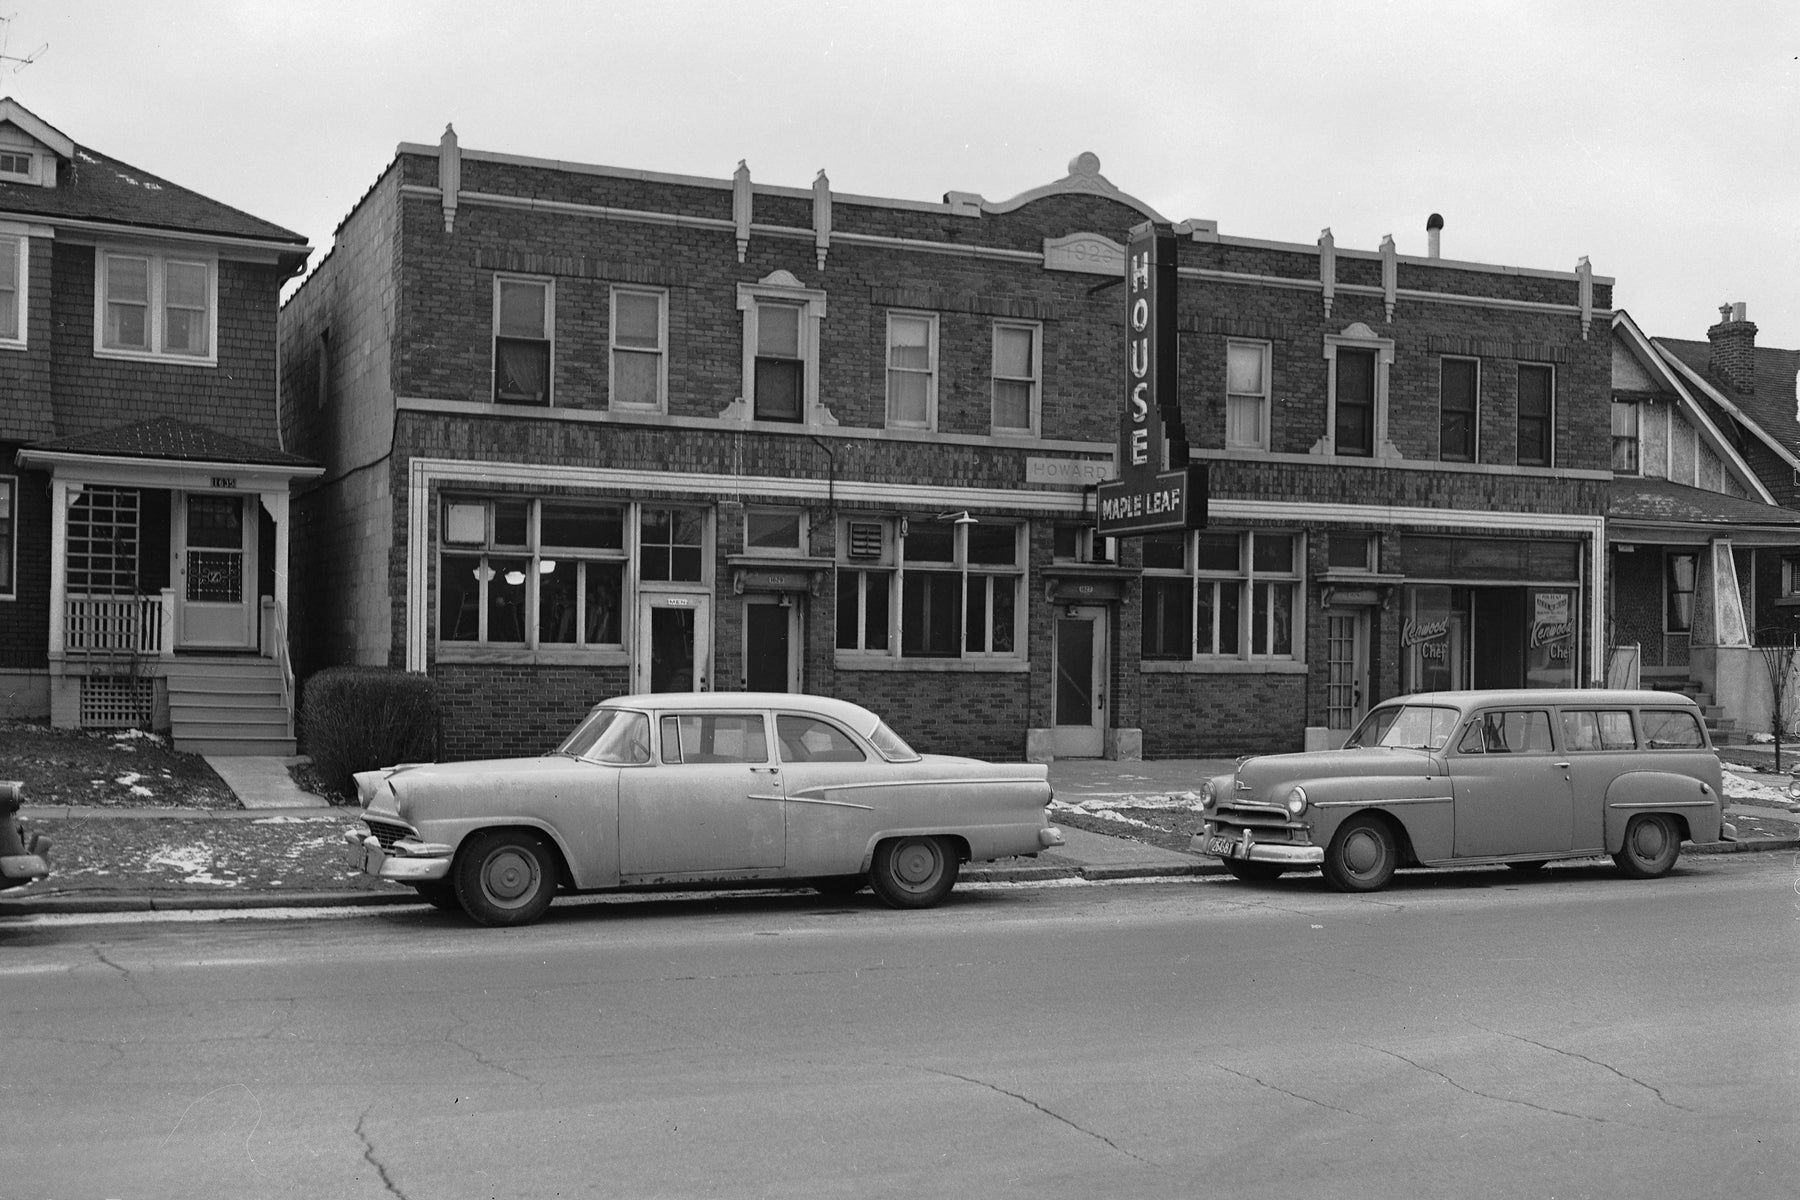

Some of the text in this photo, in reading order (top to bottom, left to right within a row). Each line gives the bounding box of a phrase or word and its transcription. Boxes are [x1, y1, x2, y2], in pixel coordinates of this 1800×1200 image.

[1130, 251, 1149, 467] HOUSE
[1033, 463, 1107, 479] HOWARD
[1102, 488, 1180, 521] MAPLE LEAF
[1401, 616, 1448, 648] Kenwood
[1530, 618, 1573, 649] Kenwood
[1422, 642, 1448, 662] Chef
